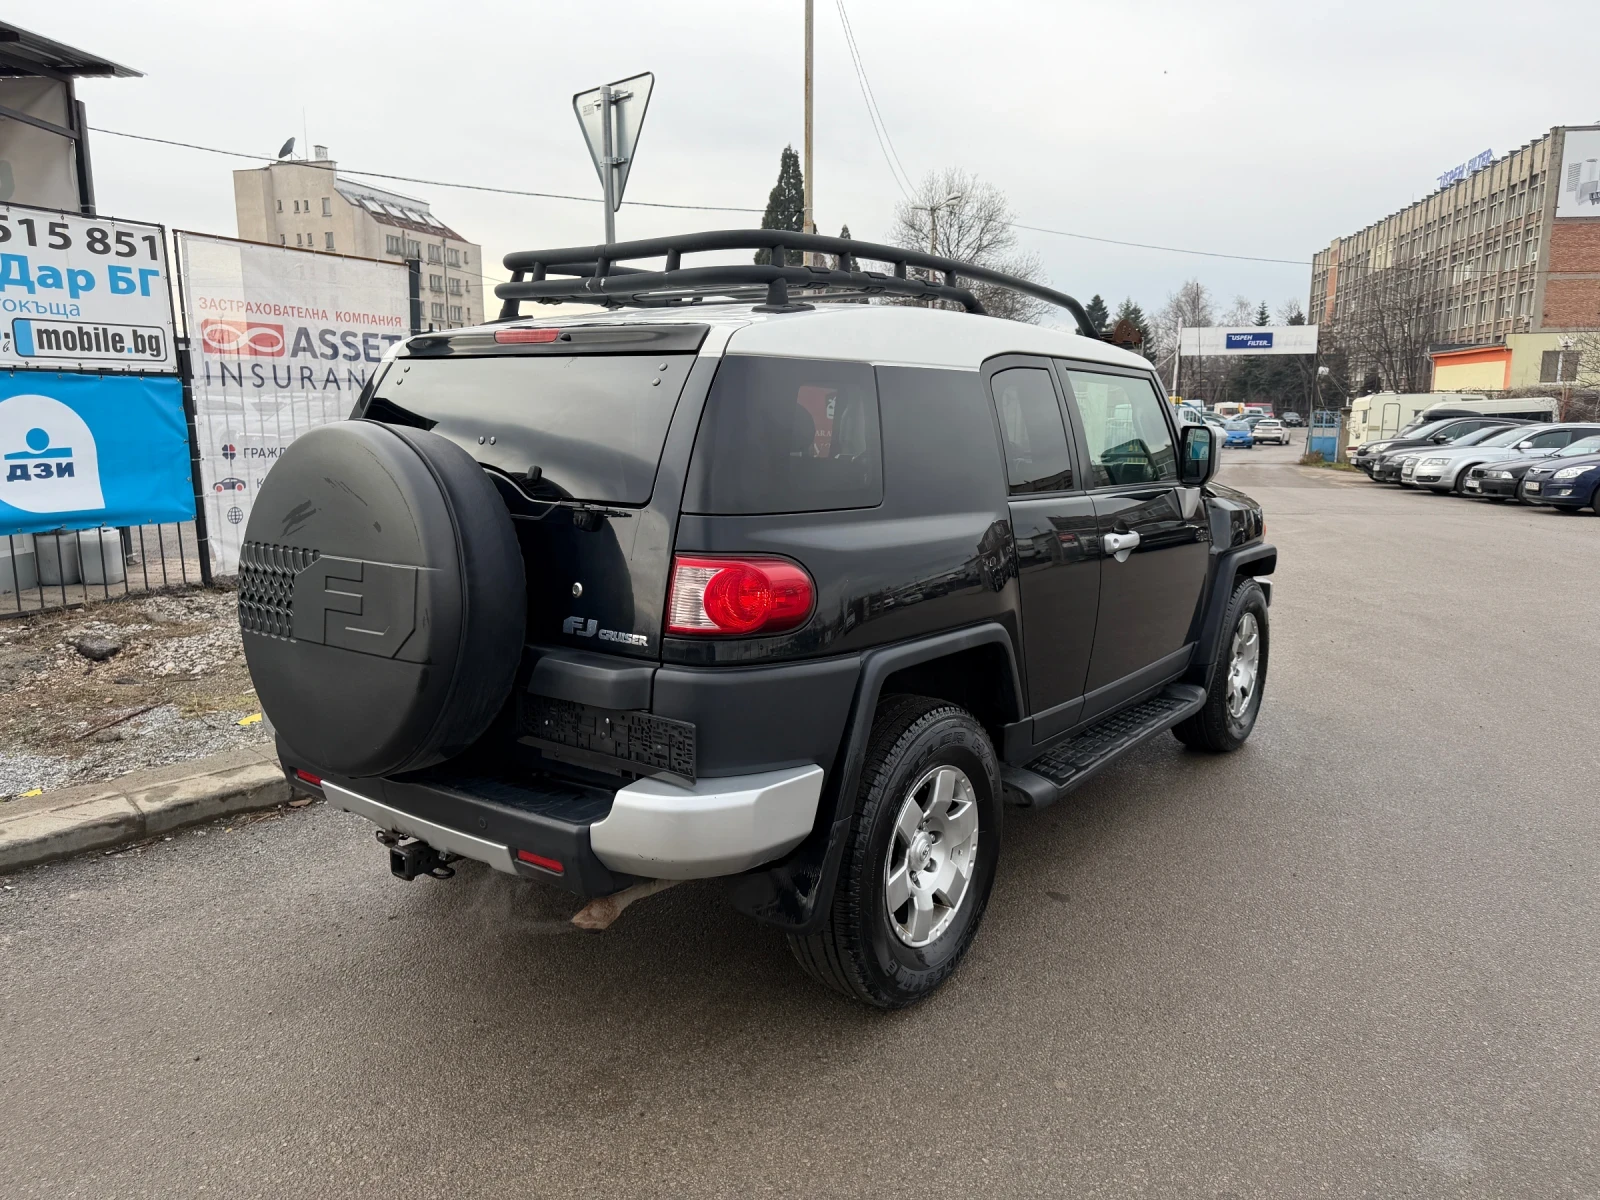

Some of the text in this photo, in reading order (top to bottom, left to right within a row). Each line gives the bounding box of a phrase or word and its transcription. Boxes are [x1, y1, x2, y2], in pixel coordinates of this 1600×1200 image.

[86, 227, 158, 261] 851
[107, 264, 160, 297] БГ
[198, 296, 402, 328] ЗАСТРАХОВАТЕЛНА КОМПАНИЯ
[36, 325, 162, 358] mobile.bg
[290, 326, 402, 363] ASSET
[6, 461, 75, 482] ДЗИ
[563, 616, 648, 647] FJ CRUISER
